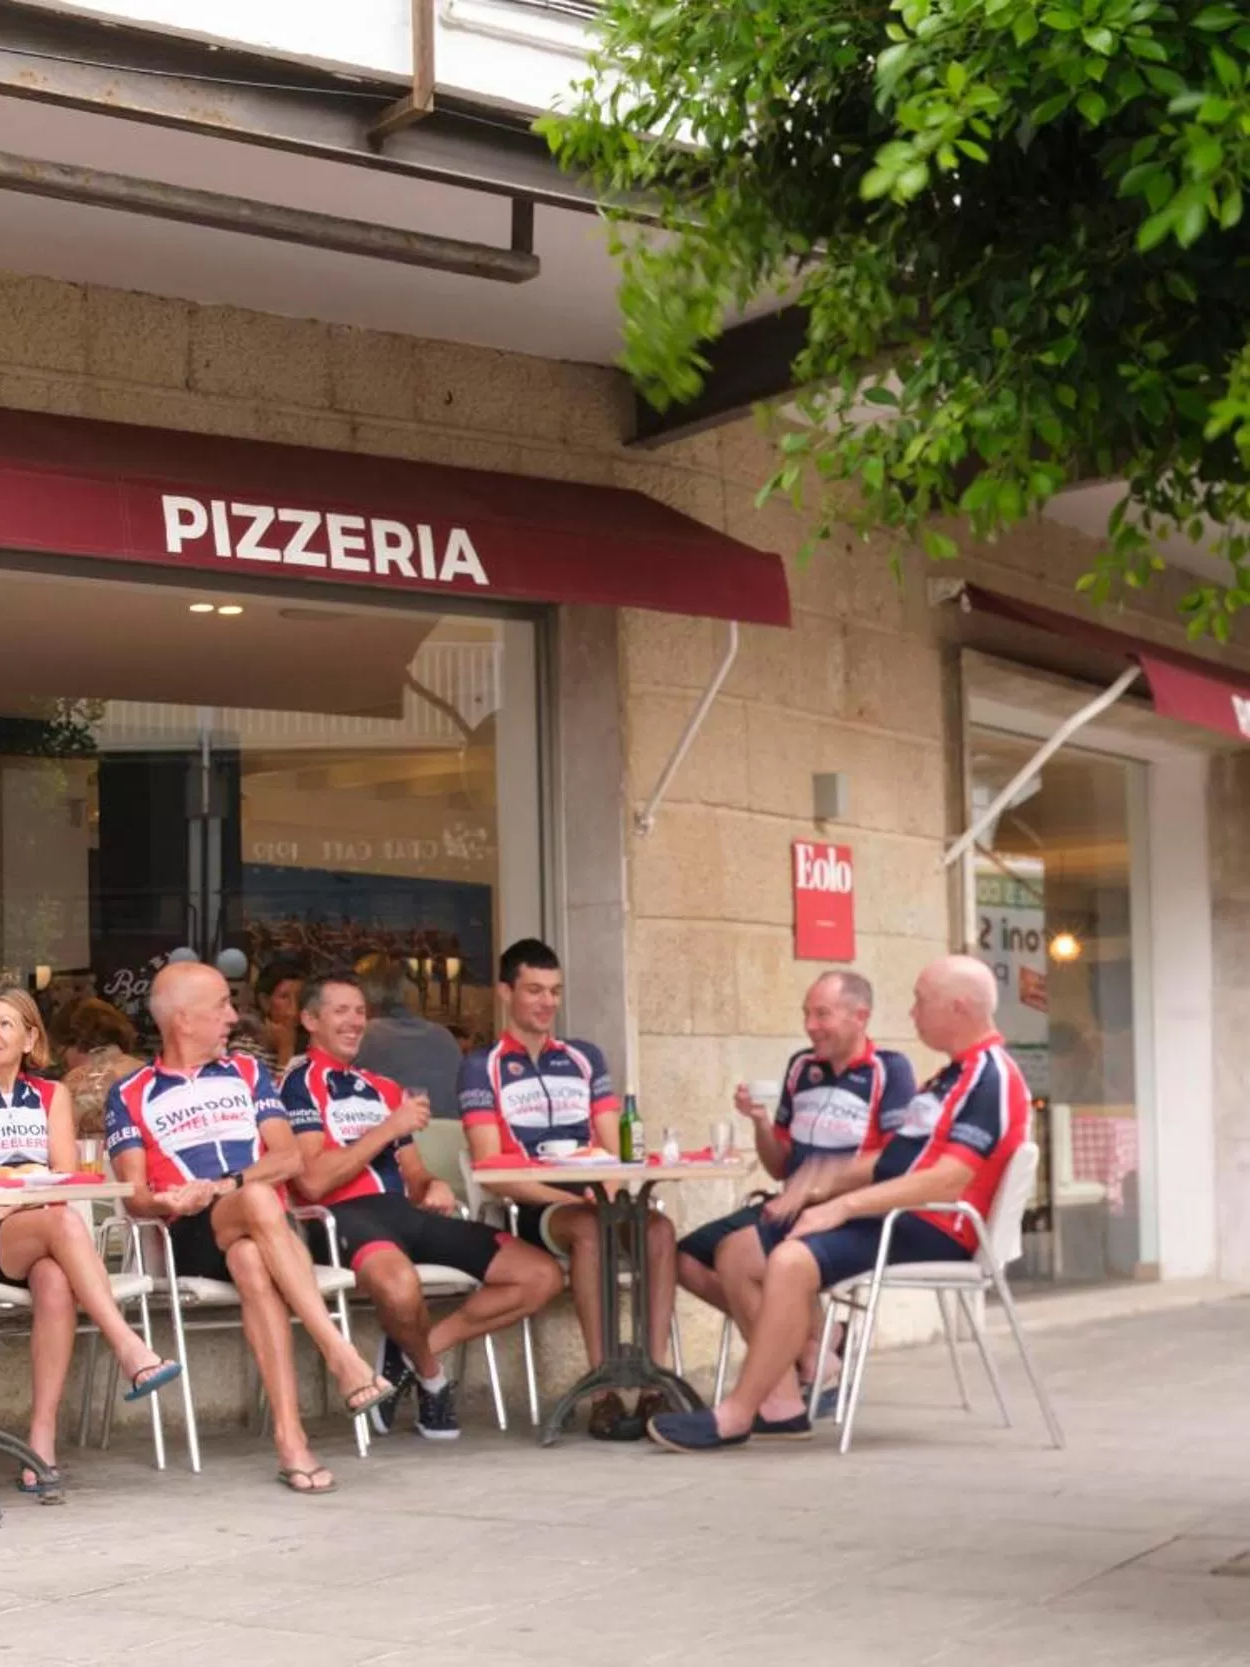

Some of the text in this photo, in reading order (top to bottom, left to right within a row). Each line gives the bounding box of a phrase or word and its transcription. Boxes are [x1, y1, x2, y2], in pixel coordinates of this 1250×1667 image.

[161, 494, 489, 585] PIZZERIA
[794, 843, 852, 893] Eolo
[155, 1094, 249, 1133] SWINDON
